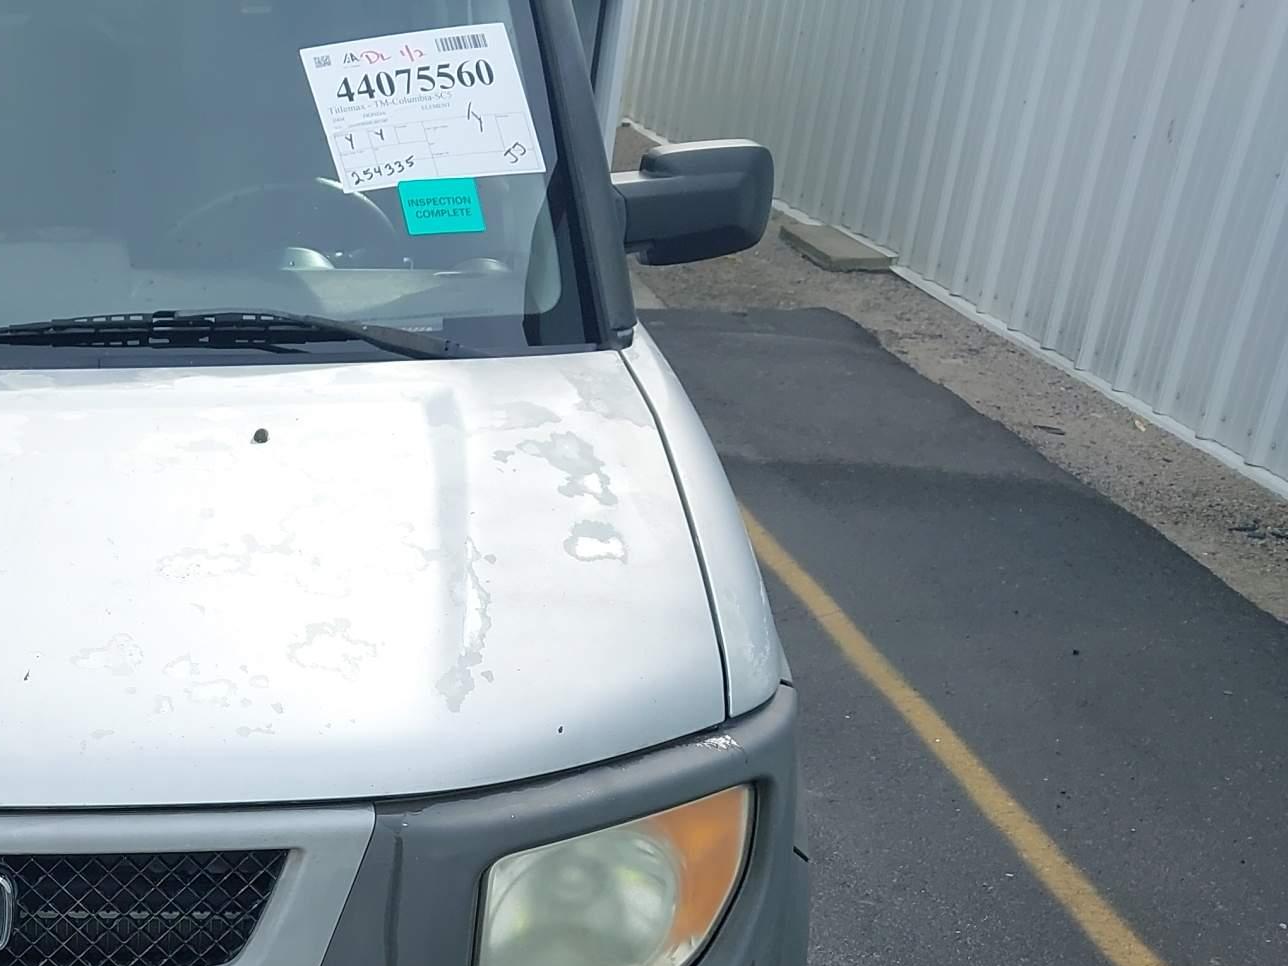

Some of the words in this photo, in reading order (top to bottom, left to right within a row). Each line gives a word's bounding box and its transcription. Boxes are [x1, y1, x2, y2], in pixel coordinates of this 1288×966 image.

[337, 59, 494, 102] 44075560
[351, 155, 415, 185] 254335
[407, 196, 472, 207] INSPECTION
[415, 208, 473, 219] COMPLETE
